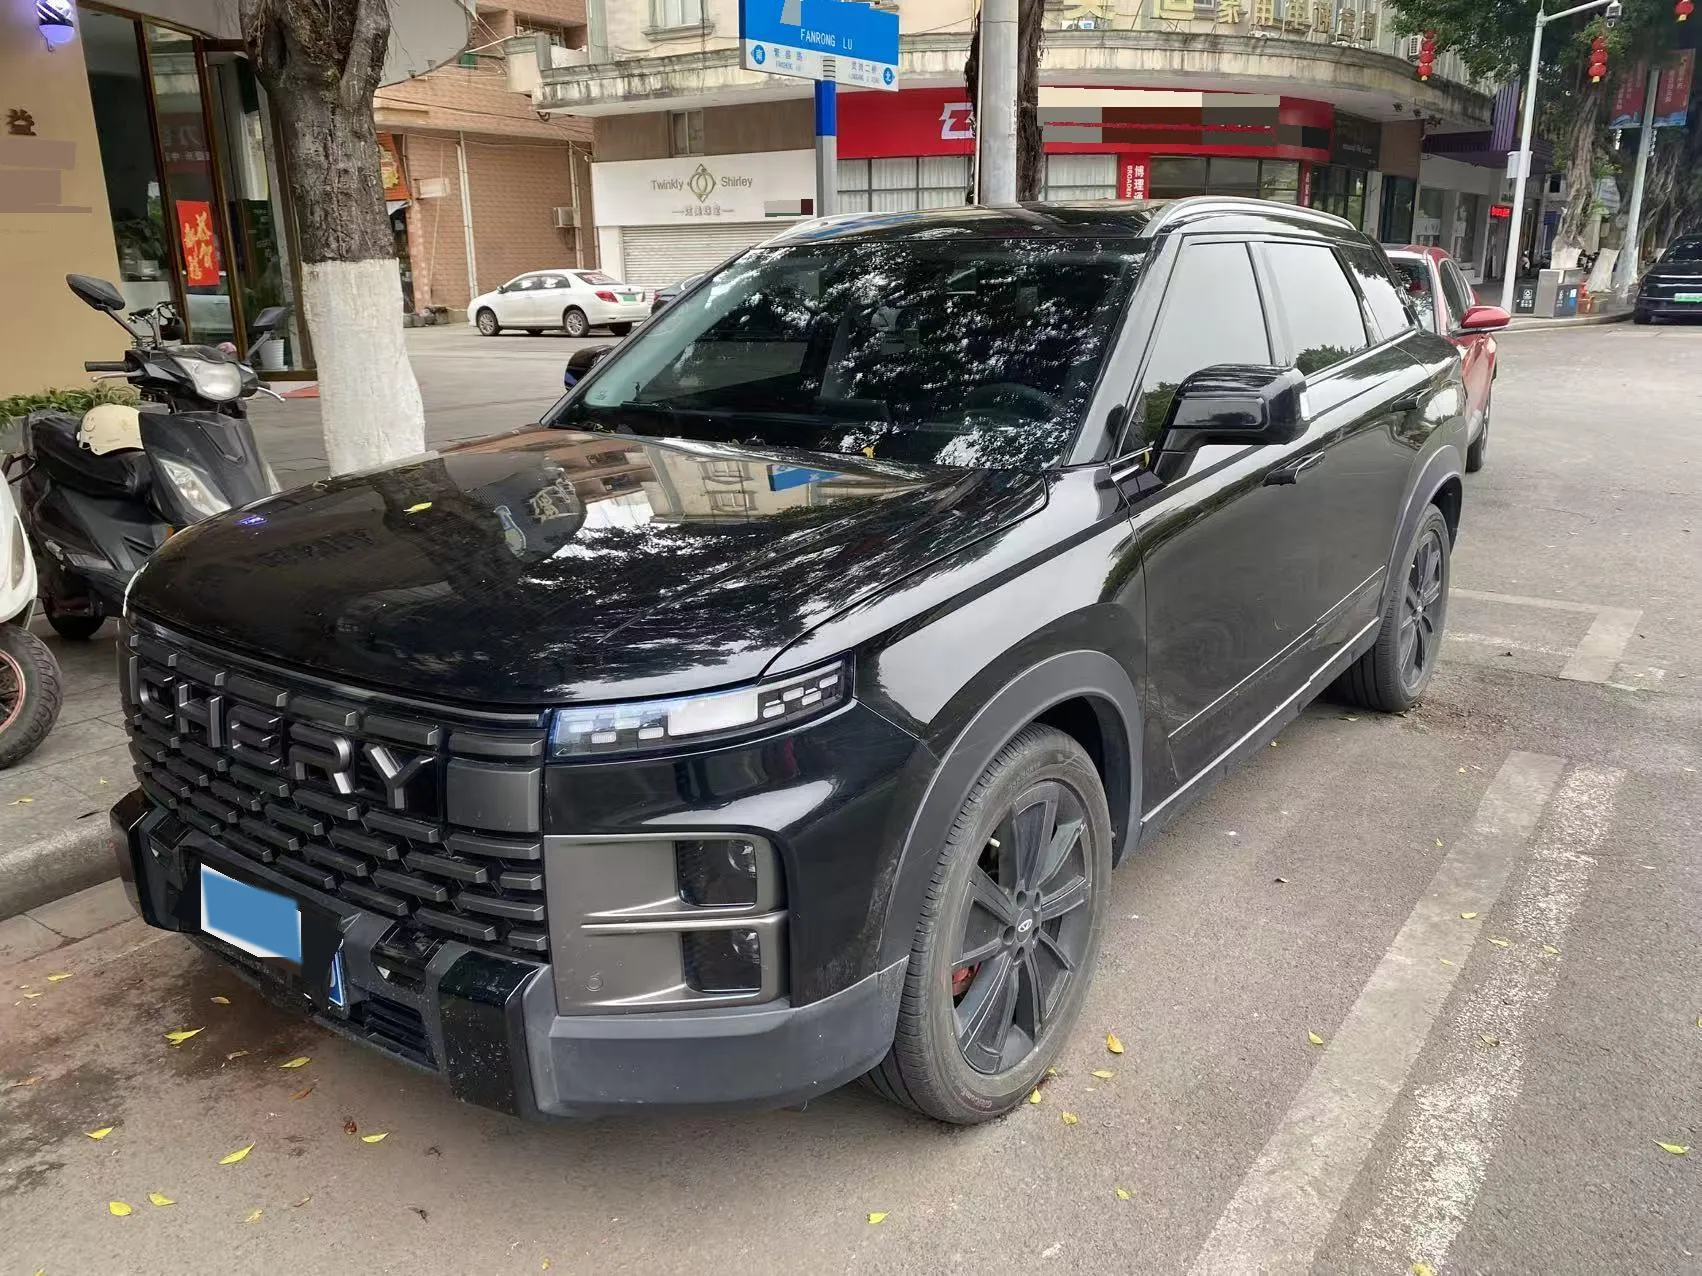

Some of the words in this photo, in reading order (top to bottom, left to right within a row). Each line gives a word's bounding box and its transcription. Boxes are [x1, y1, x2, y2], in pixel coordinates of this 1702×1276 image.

[800, 28, 836, 48] FANRONG
[842, 37, 853, 50] LU
[651, 179, 684, 191] Twinkly
[721, 176, 753, 187] Shirley
[139, 672, 437, 811] CHERY
